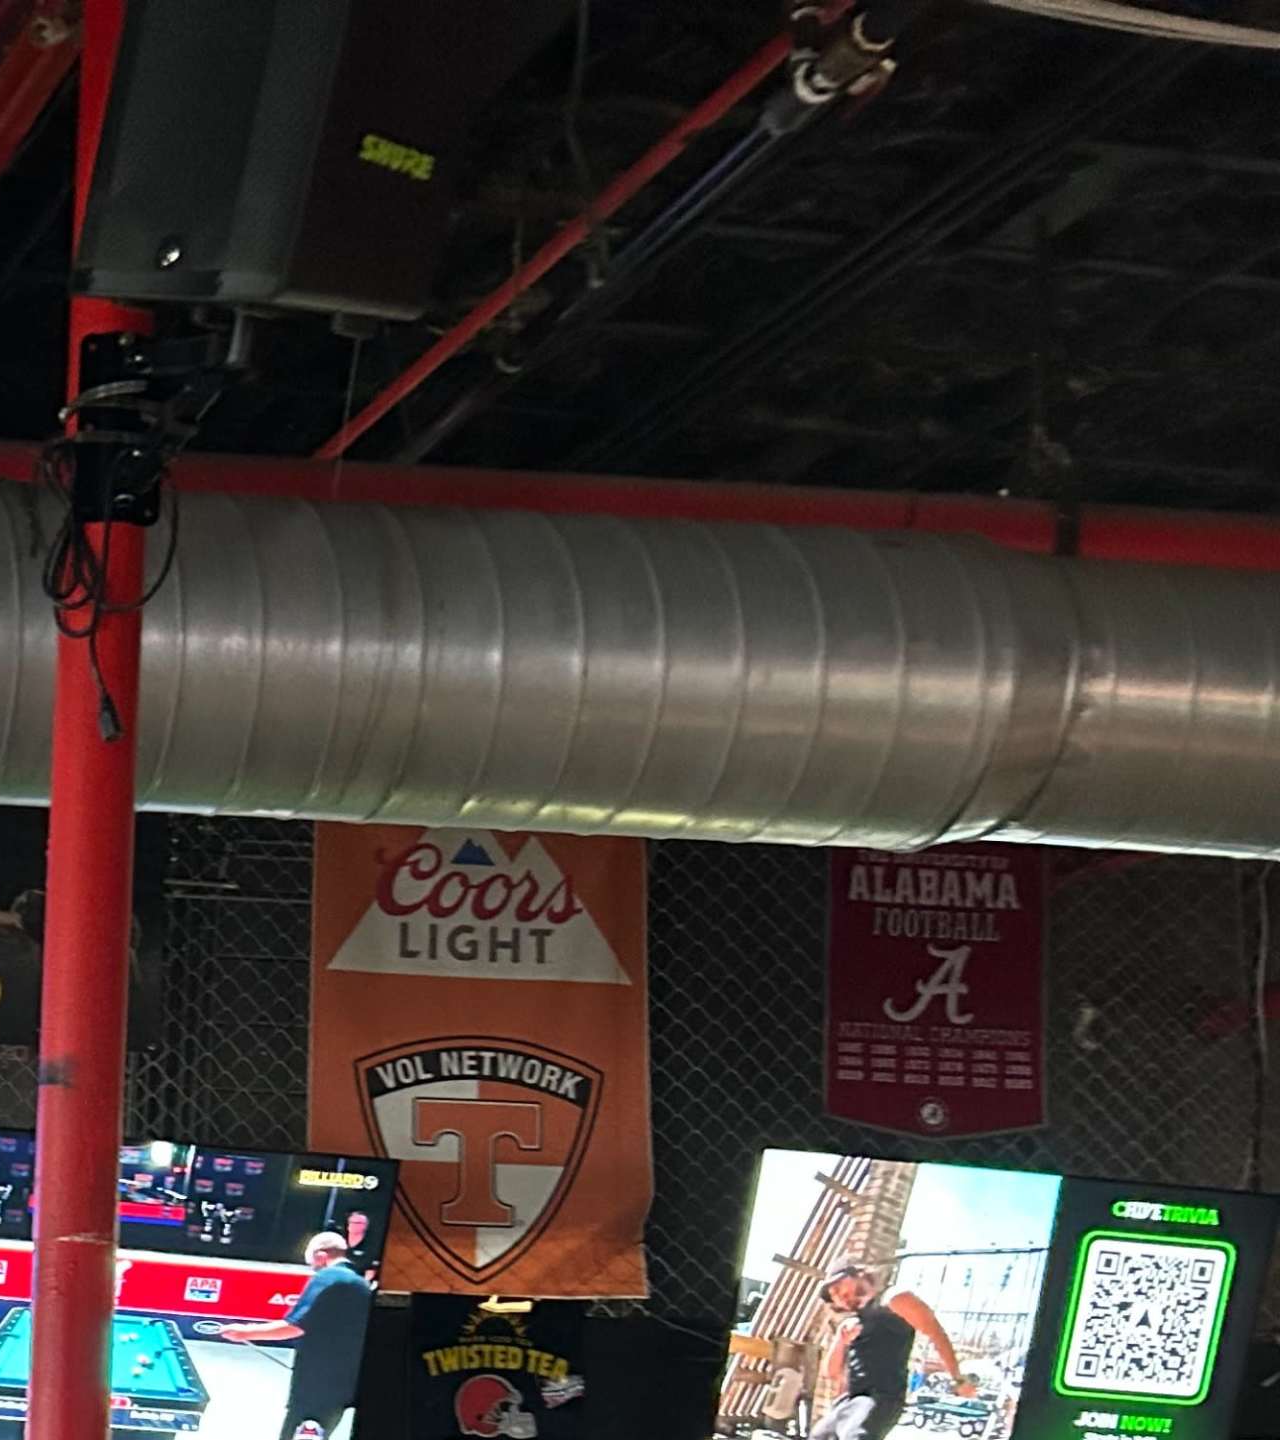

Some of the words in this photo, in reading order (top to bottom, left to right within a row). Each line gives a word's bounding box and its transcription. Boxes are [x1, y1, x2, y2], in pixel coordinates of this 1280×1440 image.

[377, 841, 583, 924] Coors
[848, 864, 1020, 909] ALABAMA
[399, 922, 557, 964] LIGHT
[872, 906, 1001, 942] FOOTBALL
[375, 1059, 433, 1090] VOL
[441, 1050, 585, 1100] NETWORK
[189, 1278, 219, 1290] APA
[422, 1344, 524, 1377] TWISTED
[526, 1349, 570, 1382] TEA
[1074, 1411, 1118, 1430] JOIN
[1120, 1415, 1173, 1434] NOW!
